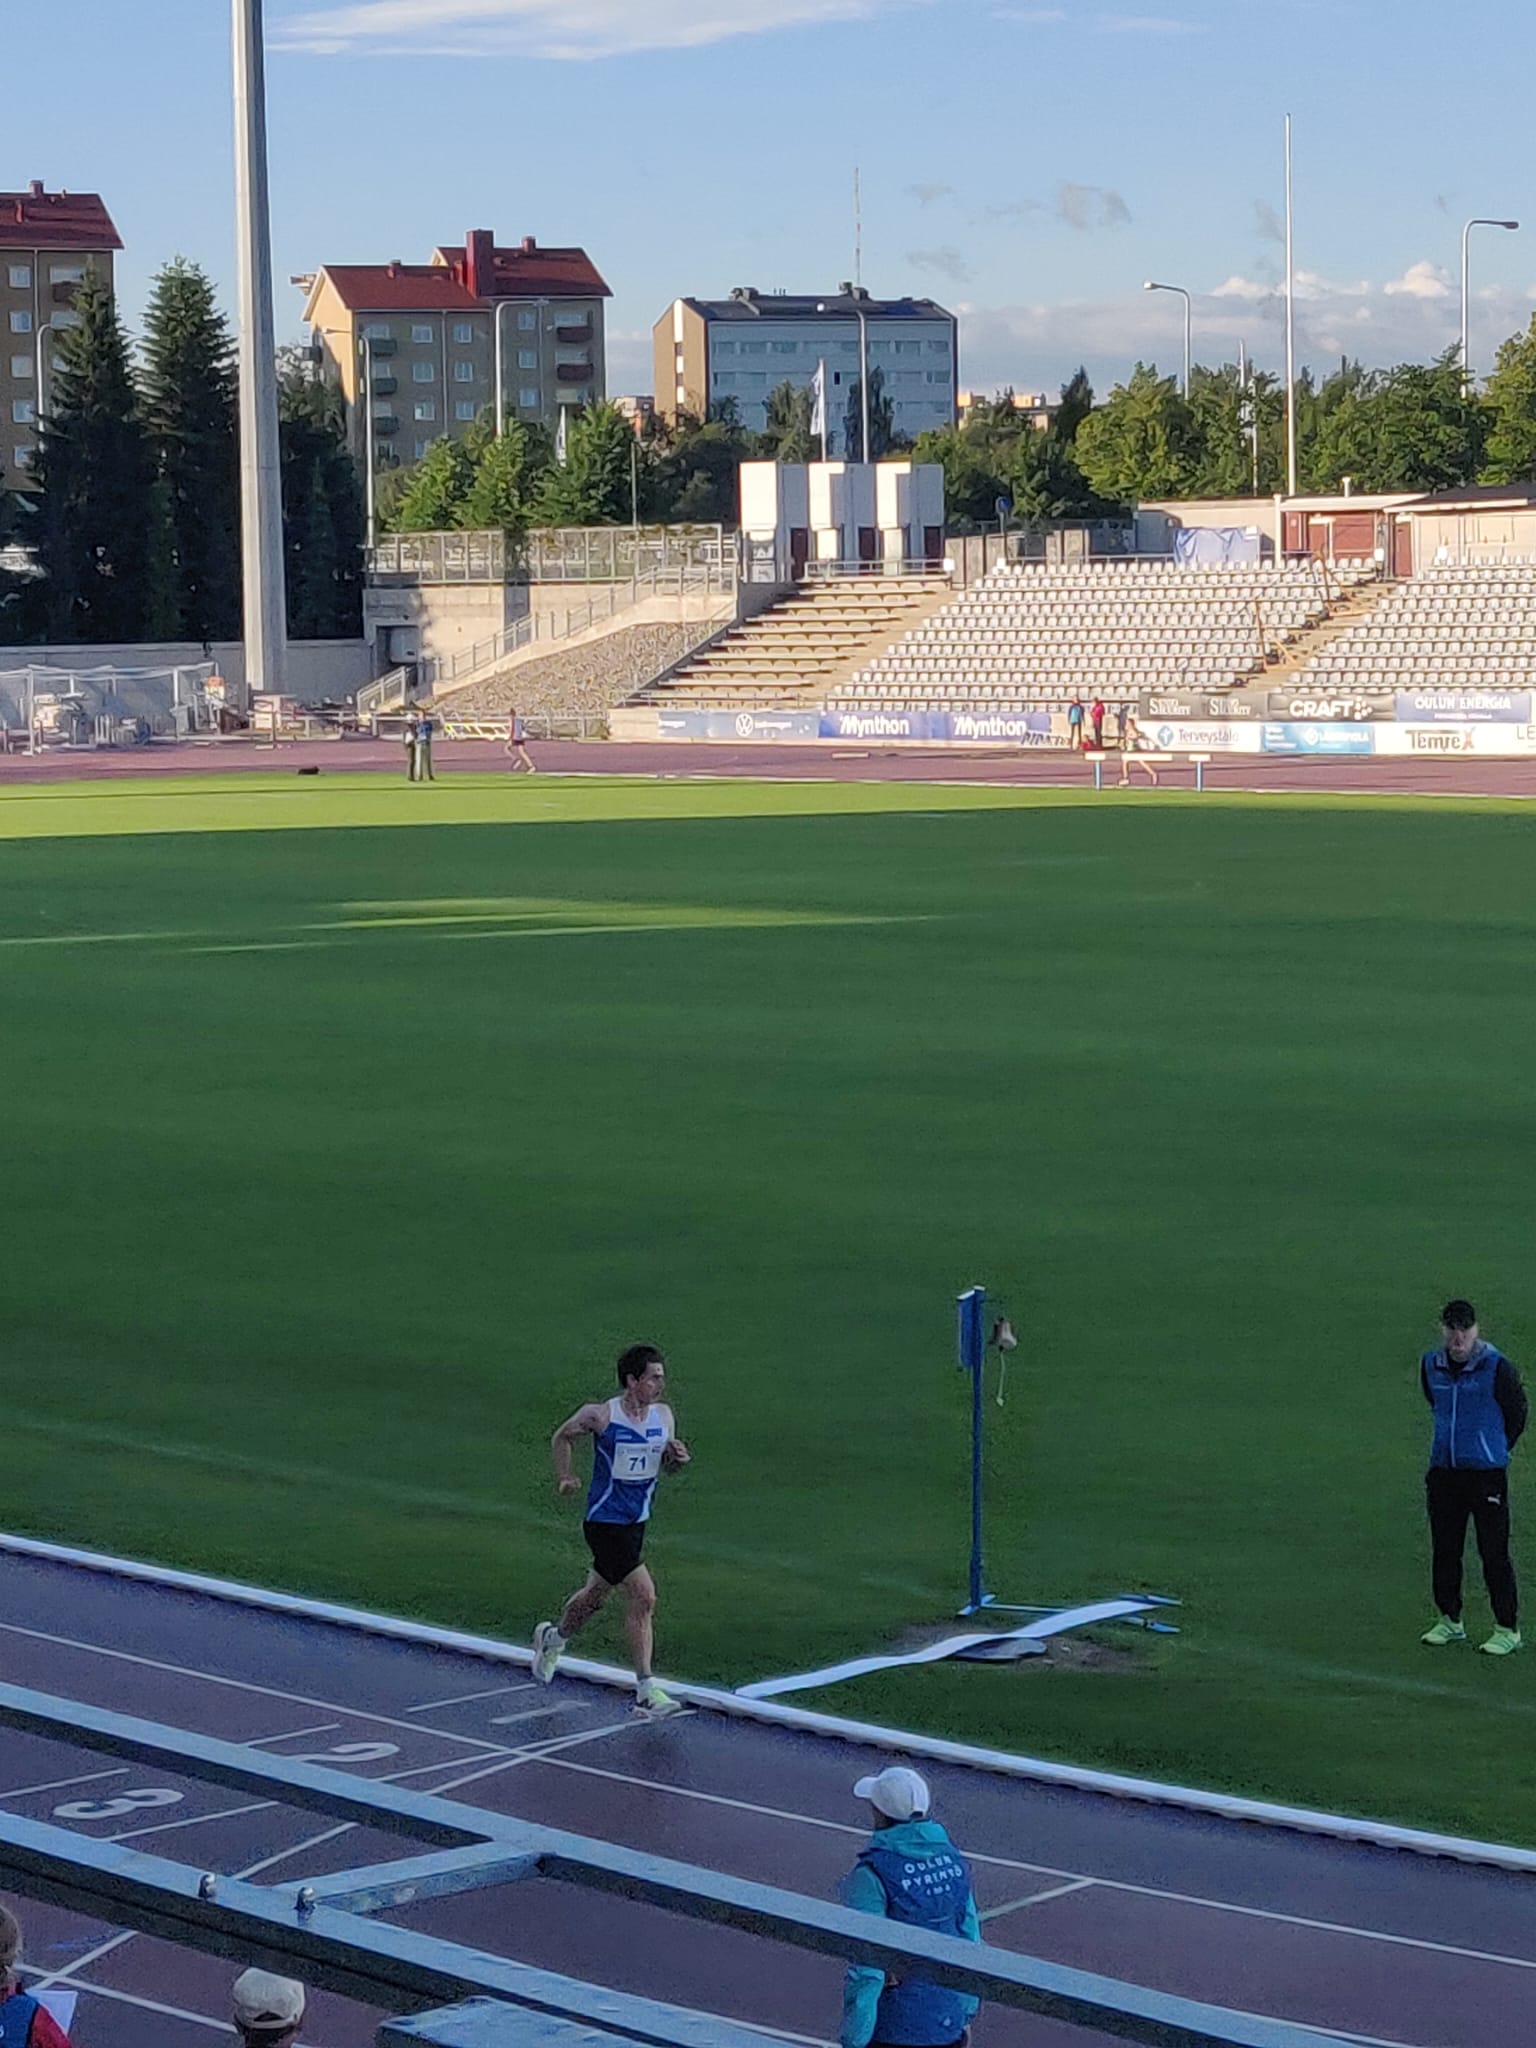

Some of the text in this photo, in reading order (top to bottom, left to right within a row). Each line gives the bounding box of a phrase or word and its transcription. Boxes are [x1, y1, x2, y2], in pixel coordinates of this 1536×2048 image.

[1289, 700, 1354, 718] CRAFT
[839, 715, 910, 738] Mynthon
[953, 715, 1027, 739] Mynthon
[1178, 728, 1239, 744] Terveystalo
[629, 1456, 646, 1471] 71
[52, 1788, 185, 1820] 3
[904, 1855, 952, 1874] OULUN
